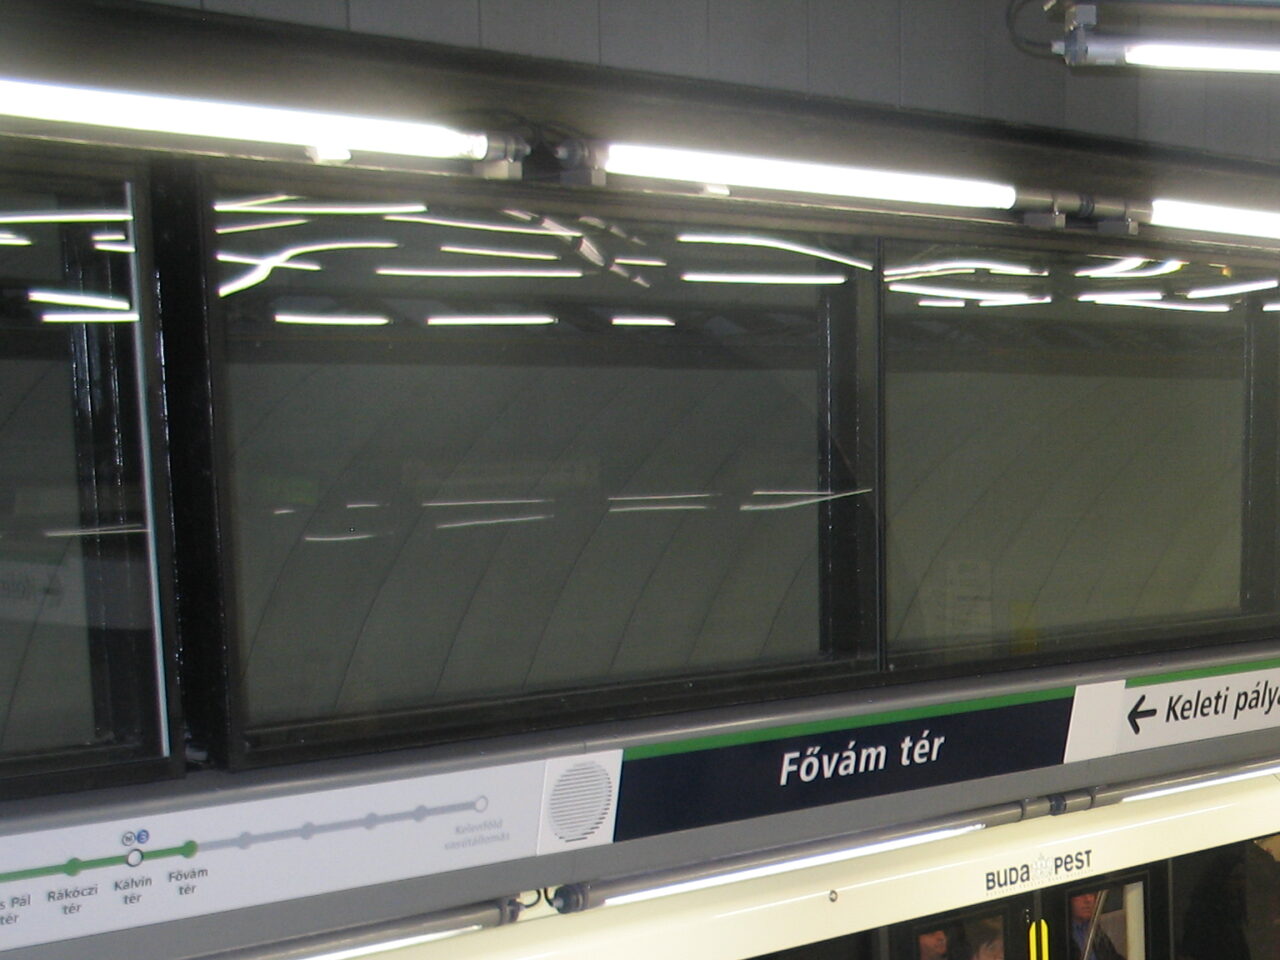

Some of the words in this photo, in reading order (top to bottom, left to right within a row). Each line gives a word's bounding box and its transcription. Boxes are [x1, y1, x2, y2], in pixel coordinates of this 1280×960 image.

[1165, 686, 1229, 723] Keleti
[780, 740, 887, 786] Fővám
[900, 730, 945, 766] tér
[168, 867, 209, 882] Fővám
[114, 876, 153, 892] Kálvin
[178, 884, 197, 896] tér
[47, 883, 99, 902] Rákóczi
[123, 893, 142, 905] tér
[11, 894, 31, 908] Pál
[62, 902, 81, 915] tér
[0, 913, 19, 926] tér
